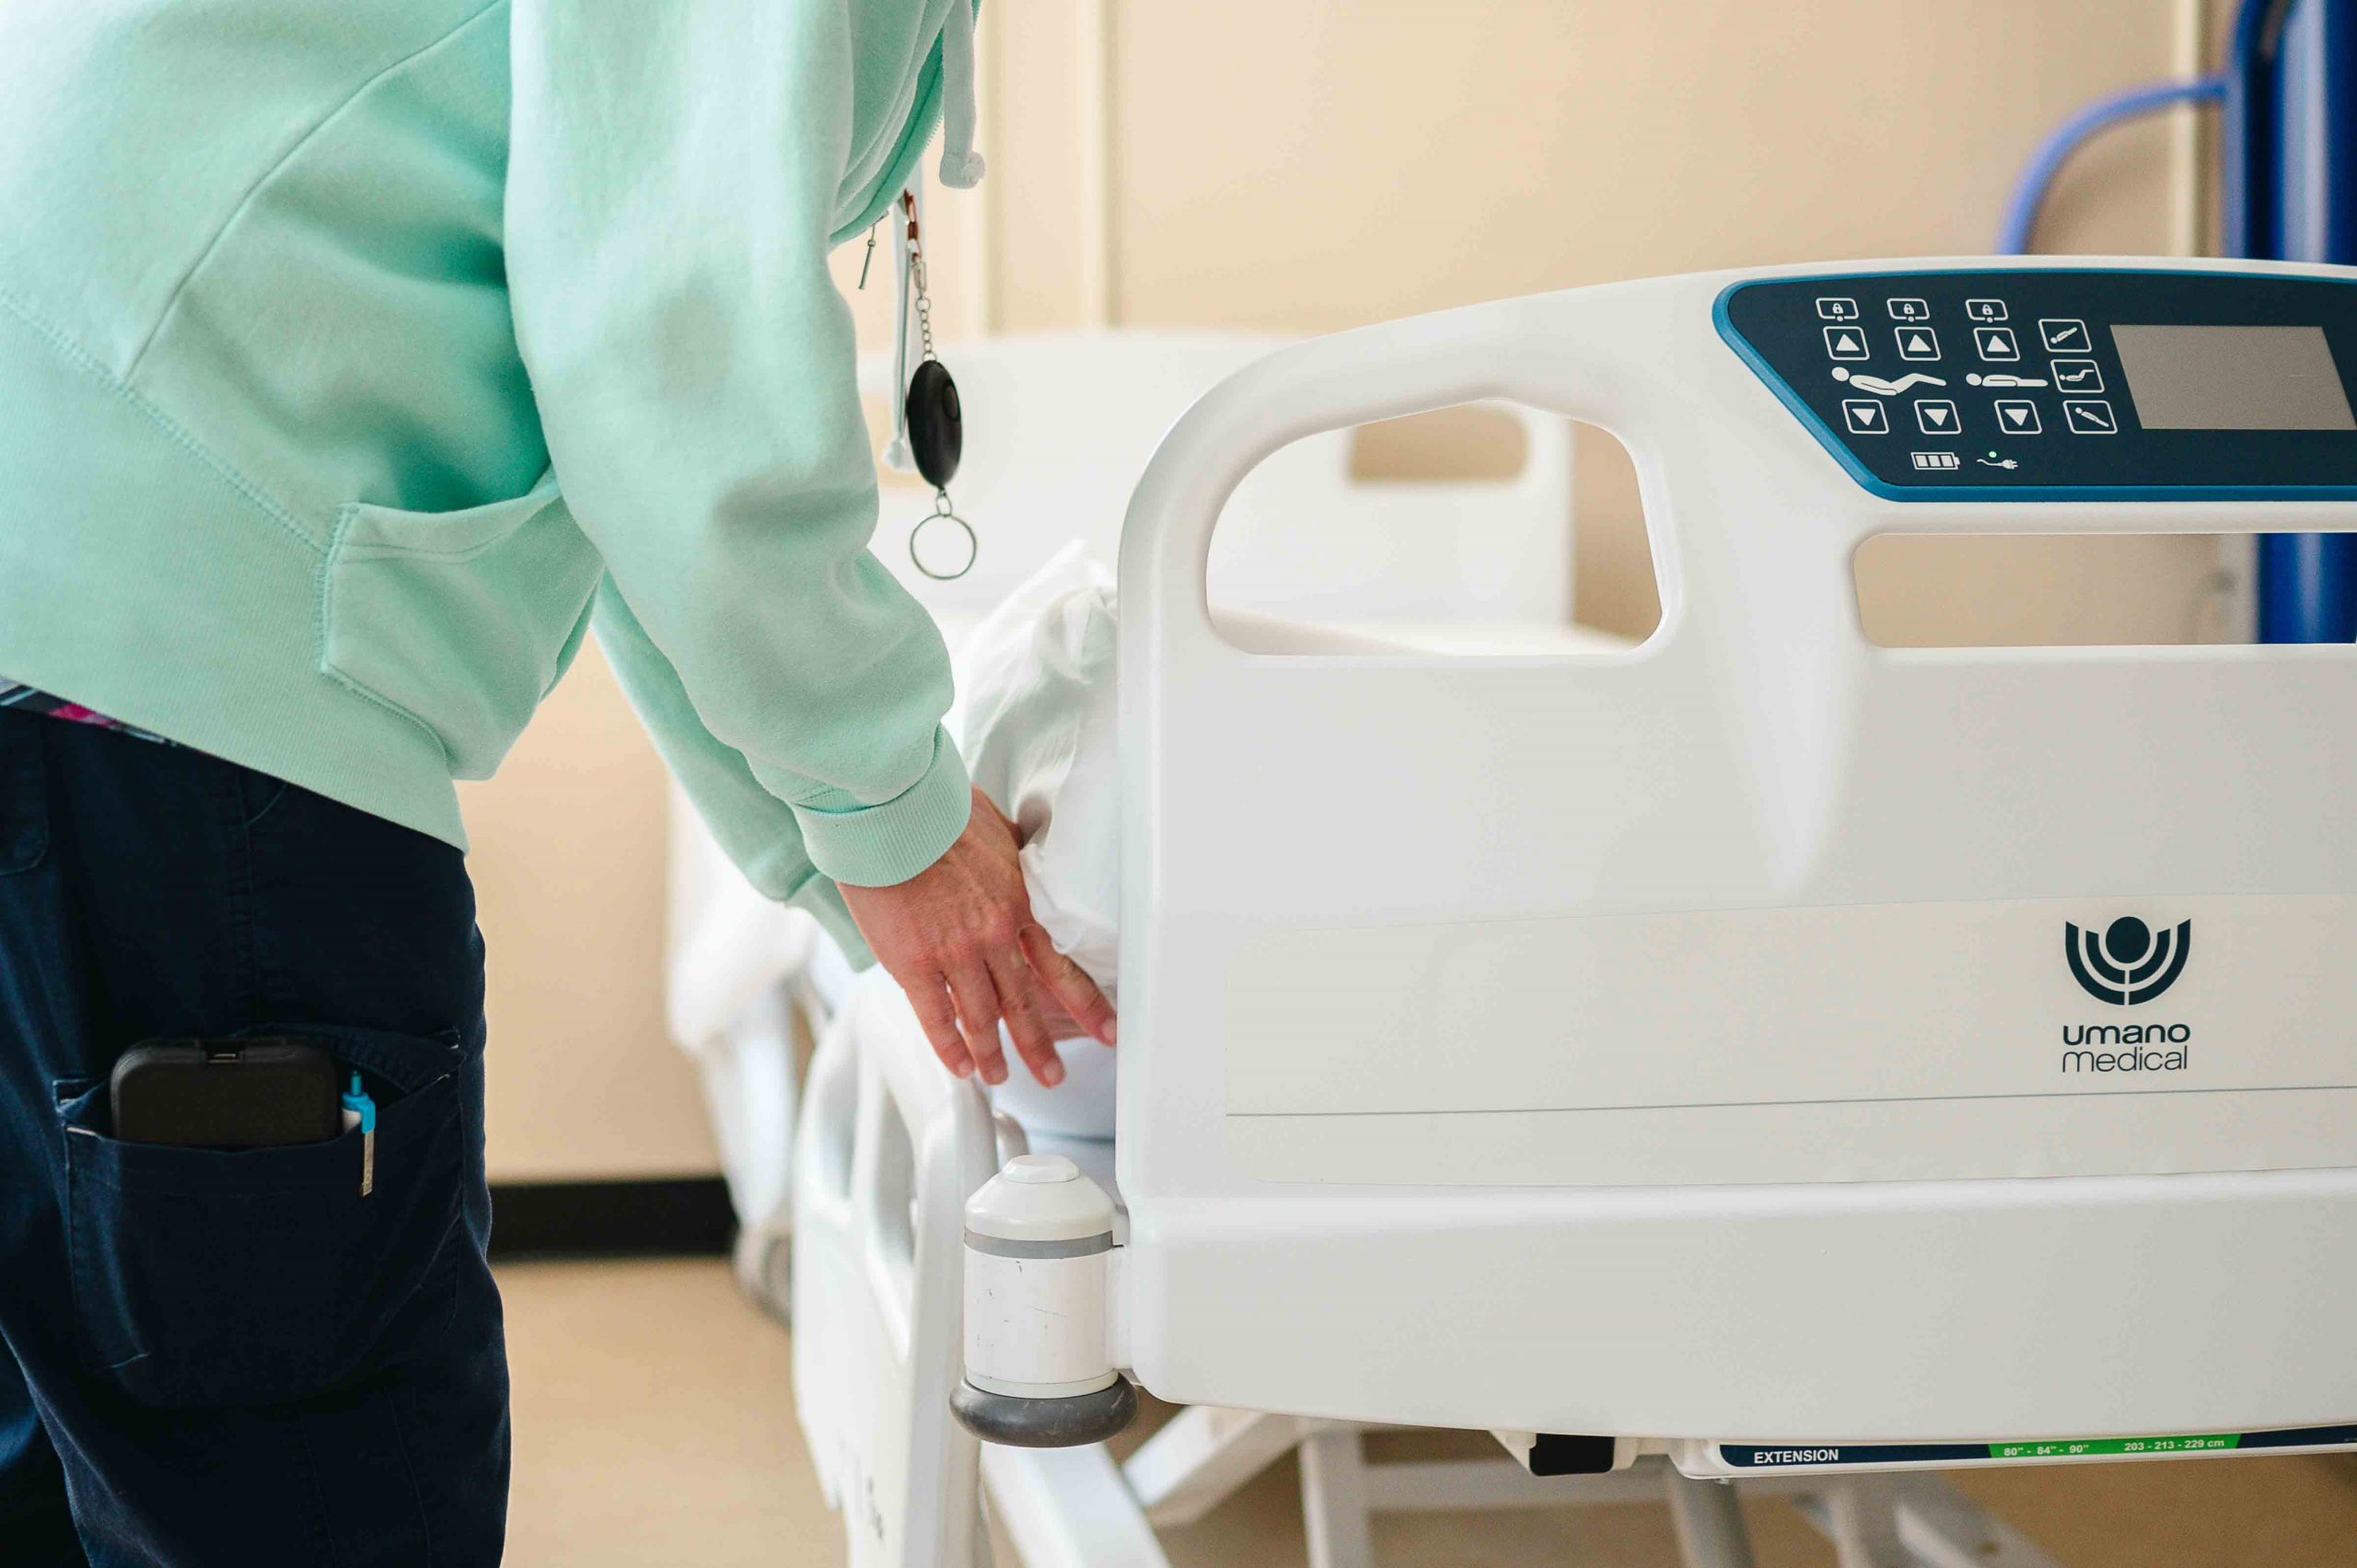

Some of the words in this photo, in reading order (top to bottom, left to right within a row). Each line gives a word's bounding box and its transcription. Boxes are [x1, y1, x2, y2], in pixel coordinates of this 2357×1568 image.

[2062, 1023, 2191, 1046] umano
[2061, 1045, 2188, 1073] medical
[2124, 1442, 2144, 1451] 203
[2154, 1441, 2175, 1450] 213
[2184, 1439, 2205, 1448] 229
[2207, 1439, 2225, 1447] cm
[1753, 1448, 1840, 1464] EXTENSION
